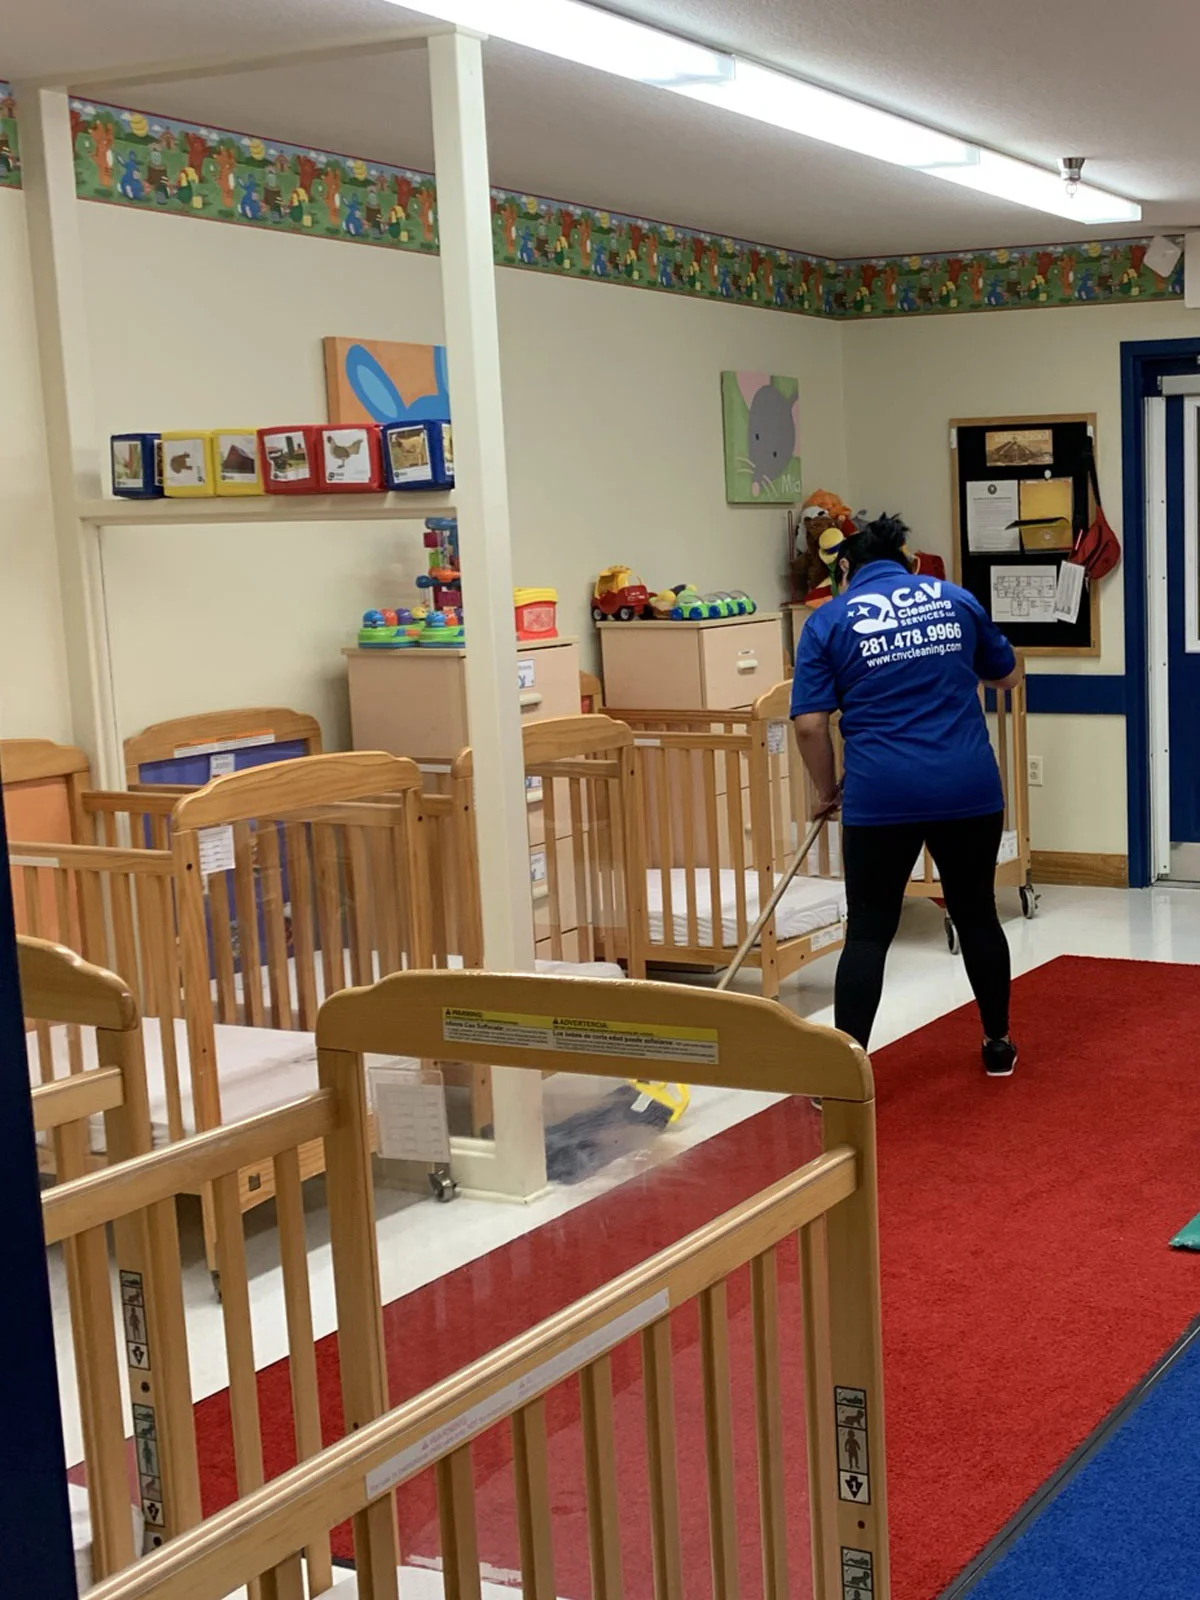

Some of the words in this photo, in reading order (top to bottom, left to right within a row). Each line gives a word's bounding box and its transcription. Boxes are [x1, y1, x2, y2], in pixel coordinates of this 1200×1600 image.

[891, 582, 942, 607] C&V
[898, 600, 952, 618] Cleaning
[900, 610, 945, 626] SERVICES
[859, 622, 962, 656] 281.478.9966
[867, 642, 962, 668] www.cnvcleaning.com
[852, 1481, 858, 1491] 1
